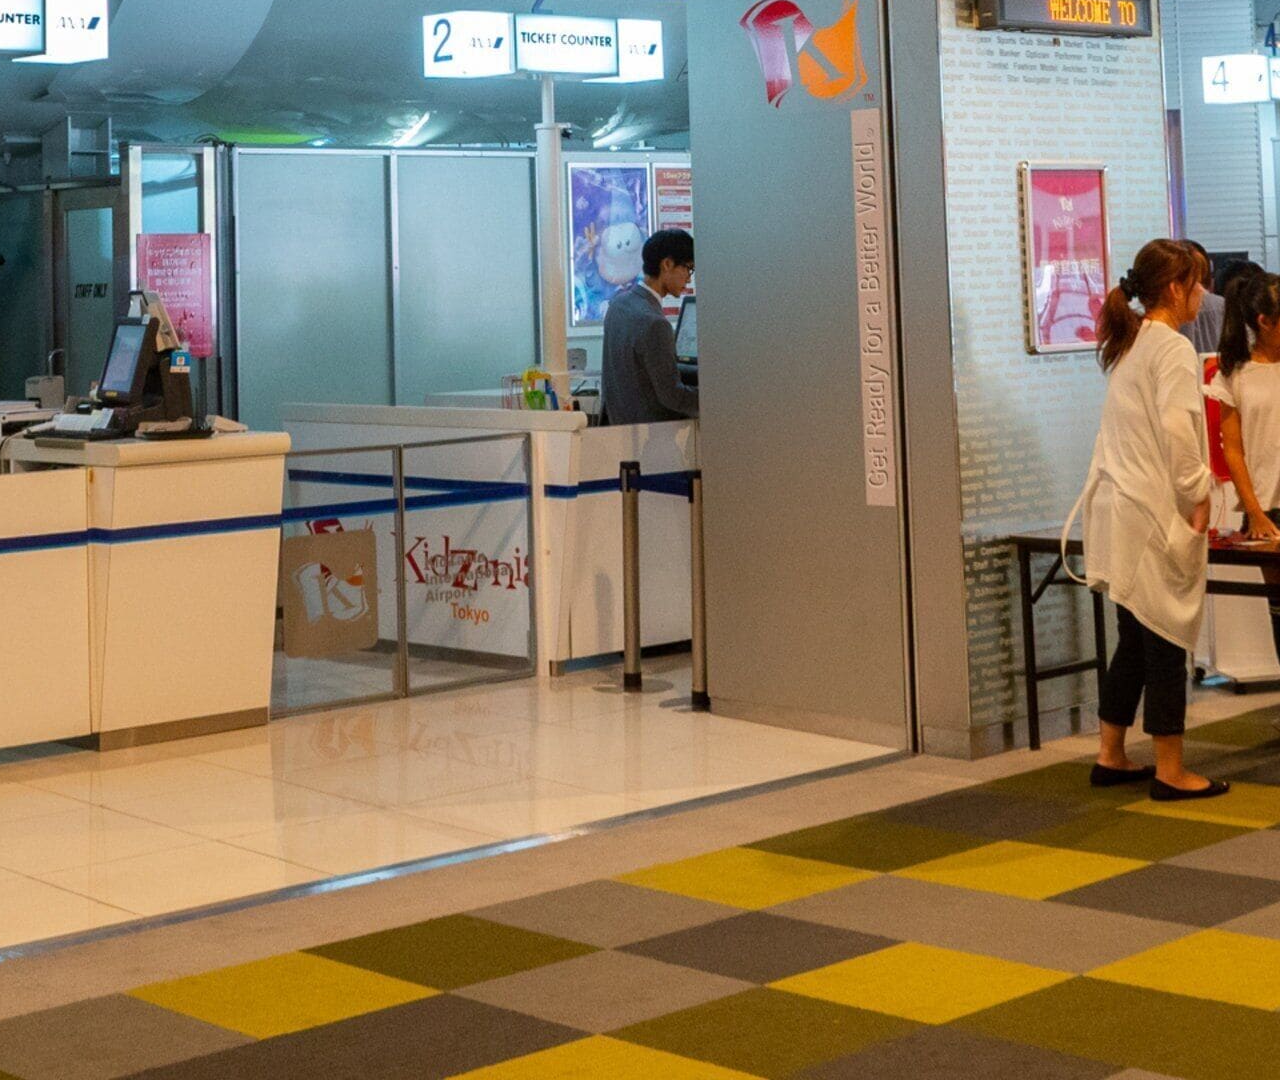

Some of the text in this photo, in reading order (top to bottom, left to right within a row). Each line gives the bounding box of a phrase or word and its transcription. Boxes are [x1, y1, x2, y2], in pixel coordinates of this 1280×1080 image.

[1117, 0, 1136, 26] TO
[433, 18, 453, 63] 2
[520, 31, 612, 47] TICKET COUNTER
[1264, 22, 1277, 57] 4
[1212, 60, 1229, 92] 4
[859, 223, 882, 292] Better
[75, 283, 93, 298] STAFF
[866, 301, 882, 315] a
[863, 319, 886, 358] for
[865, 366, 891, 438] Ready
[866, 449, 889, 490] Get
[425, 587, 473, 603] Airport
[451, 602, 490, 625] Tokyo
